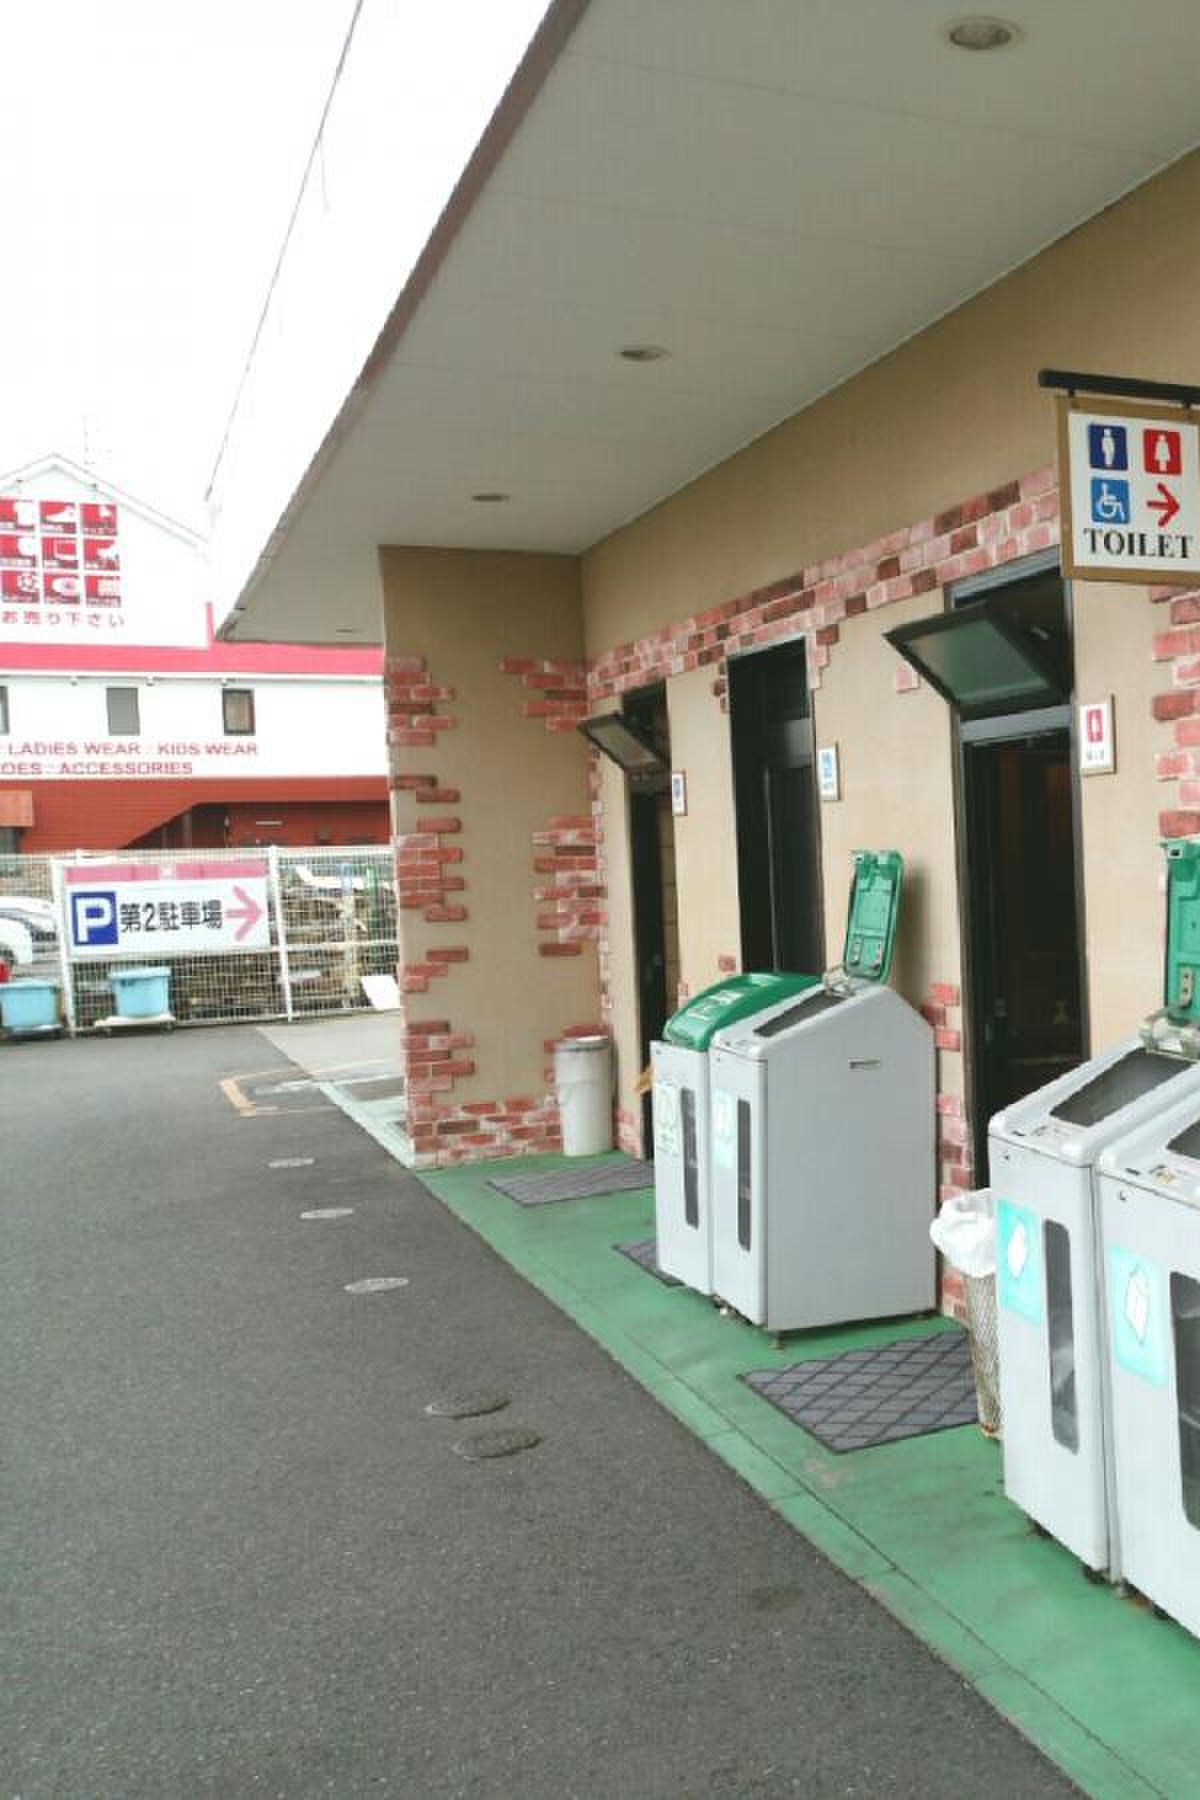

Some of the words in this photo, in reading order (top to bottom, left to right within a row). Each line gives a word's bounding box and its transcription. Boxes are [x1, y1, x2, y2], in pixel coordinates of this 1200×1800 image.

[1083, 527, 1194, 559] TOILET
[8, 742, 78, 756] LADIES
[84, 742, 141, 756] WEAR
[157, 742, 200, 756] KIDS
[205, 742, 257, 756] WEAR
[59, 761, 193, 775] ACCESSORIES
[76, 897, 112, 942] P
[119, 899, 223, 933] 第2駐車場
